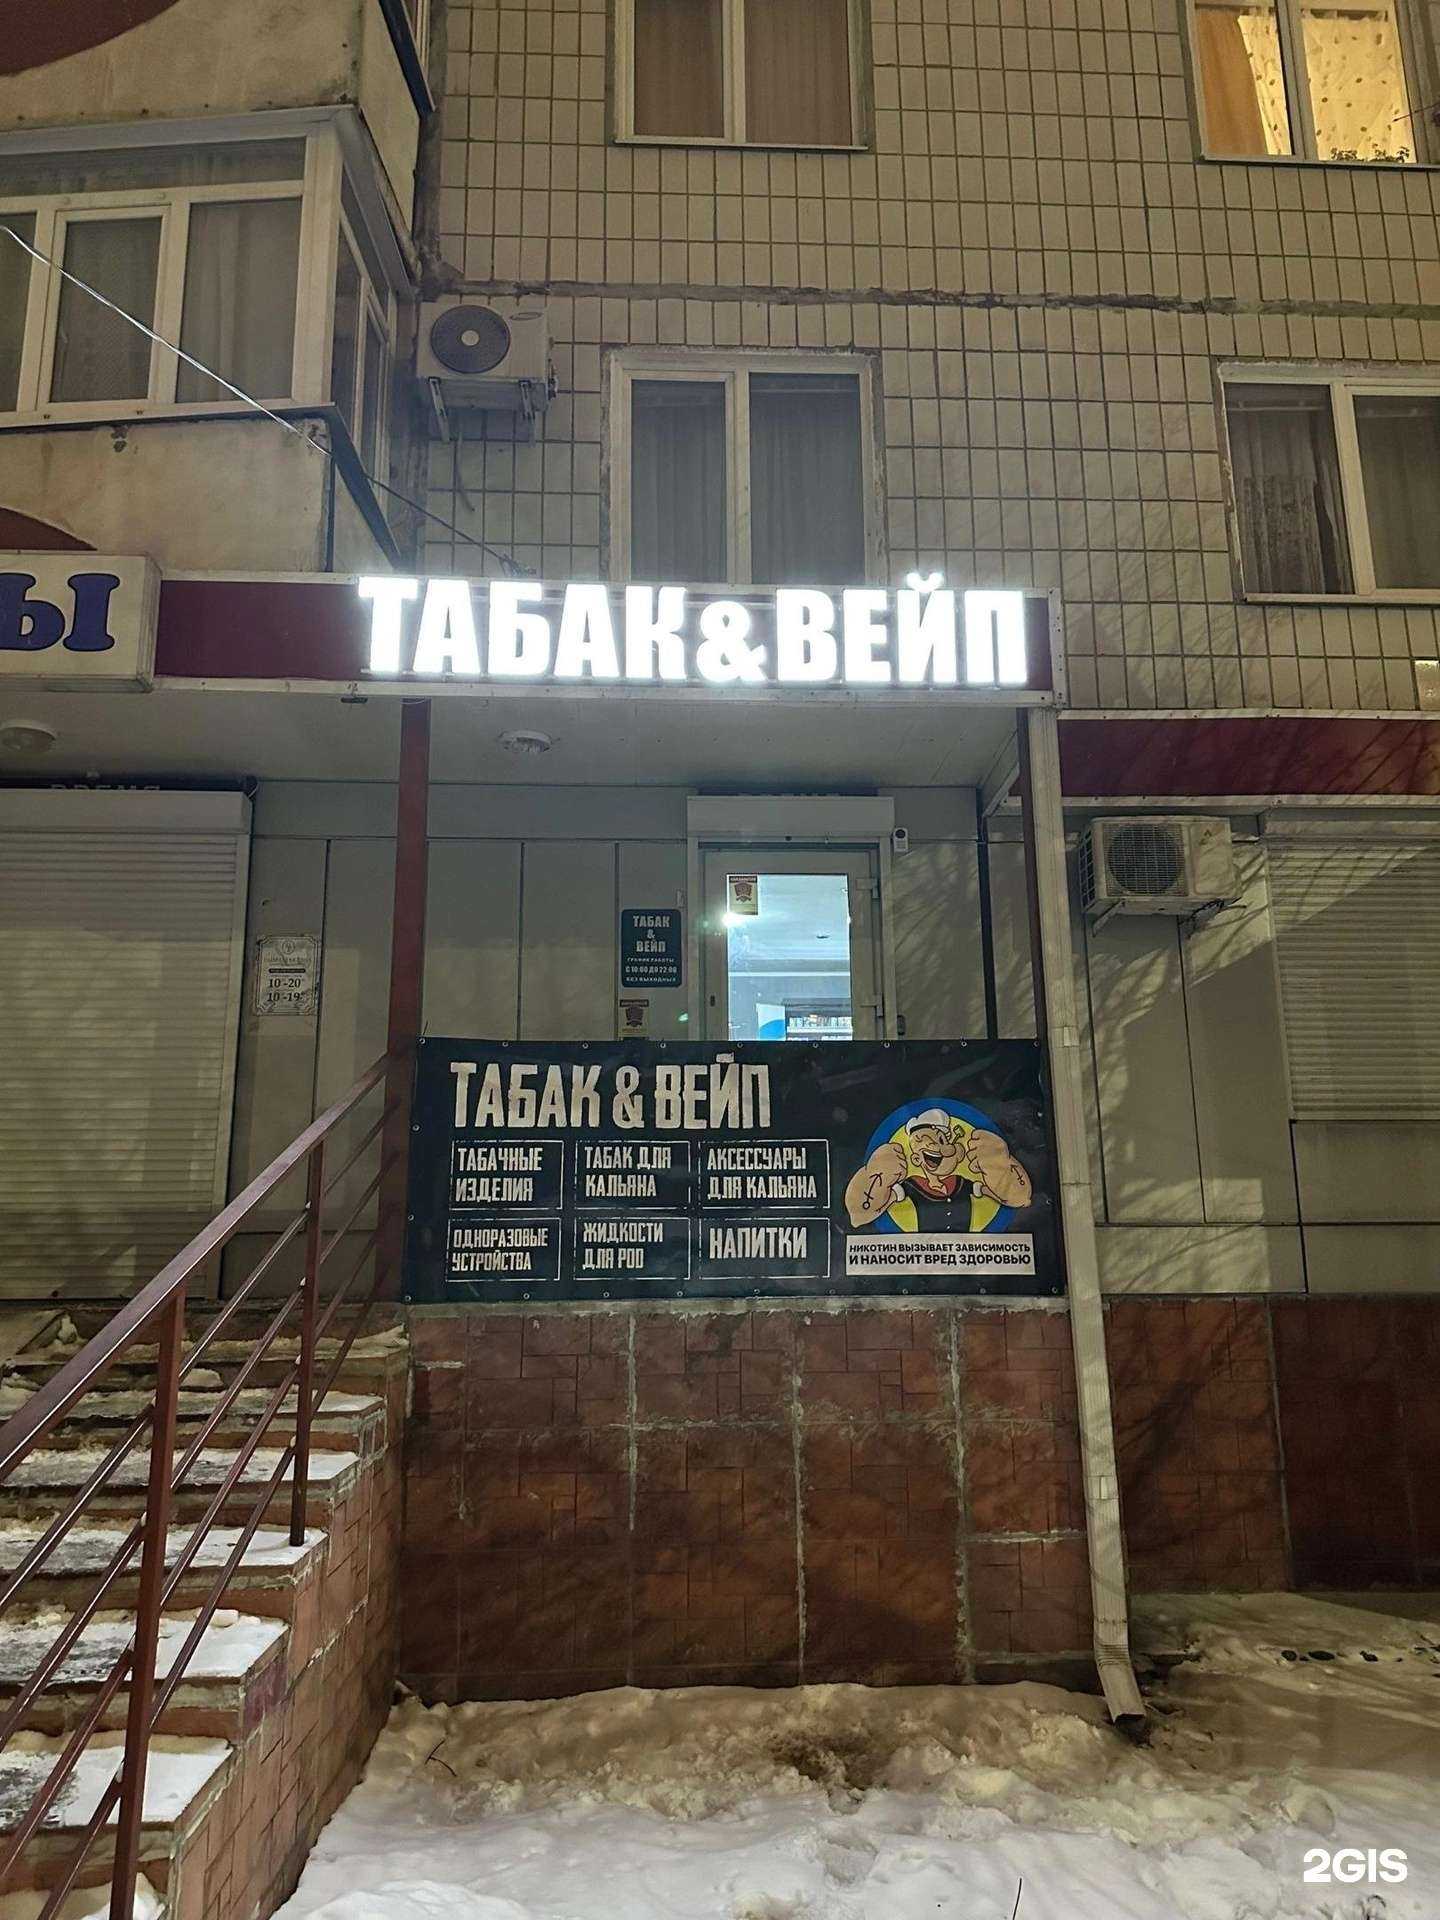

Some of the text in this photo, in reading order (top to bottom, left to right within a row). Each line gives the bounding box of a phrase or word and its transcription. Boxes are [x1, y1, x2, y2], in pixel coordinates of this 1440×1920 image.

[358, 572, 1028, 683] ТАБАК & ВЕЙП
[632, 915, 671, 928] ТАБАК
[646, 929, 656, 939] &
[636, 939, 666, 953] ВЕЙП
[450, 1051, 771, 1129] ТАБАК & ВЕЙП
[457, 1147, 543, 1171] ТАБАЧНЫЕ
[584, 1146, 671, 1170] ТАБАК ДЛЯ
[707, 1147, 806, 1170] АКСЕССУАРЫ
[455, 1177, 533, 1203] ИЗДЕЛИЯ
[585, 1174, 657, 1197] КАЛЬЯНА
[707, 1175, 817, 1200] ДЛЯ КАЛЬЯНА
[453, 1227, 548, 1249] ОДНОРАЗОВЫЕ
[583, 1221, 664, 1243] ЖИДКОСТИ
[709, 1226, 807, 1259] НАПИТКИ
[582, 1247, 614, 1270] ДЛЯ
[849, 1243, 1031, 1253] НИКОТИН ВЫЗЫВАЕТ ЗАВИСИМОСТЬ
[849, 1253, 1031, 1266] И НАНОСИТ ВРЕД ЗДОРОВЬЮ
[452, 1250, 532, 1272] УСТРОЙСТВА
